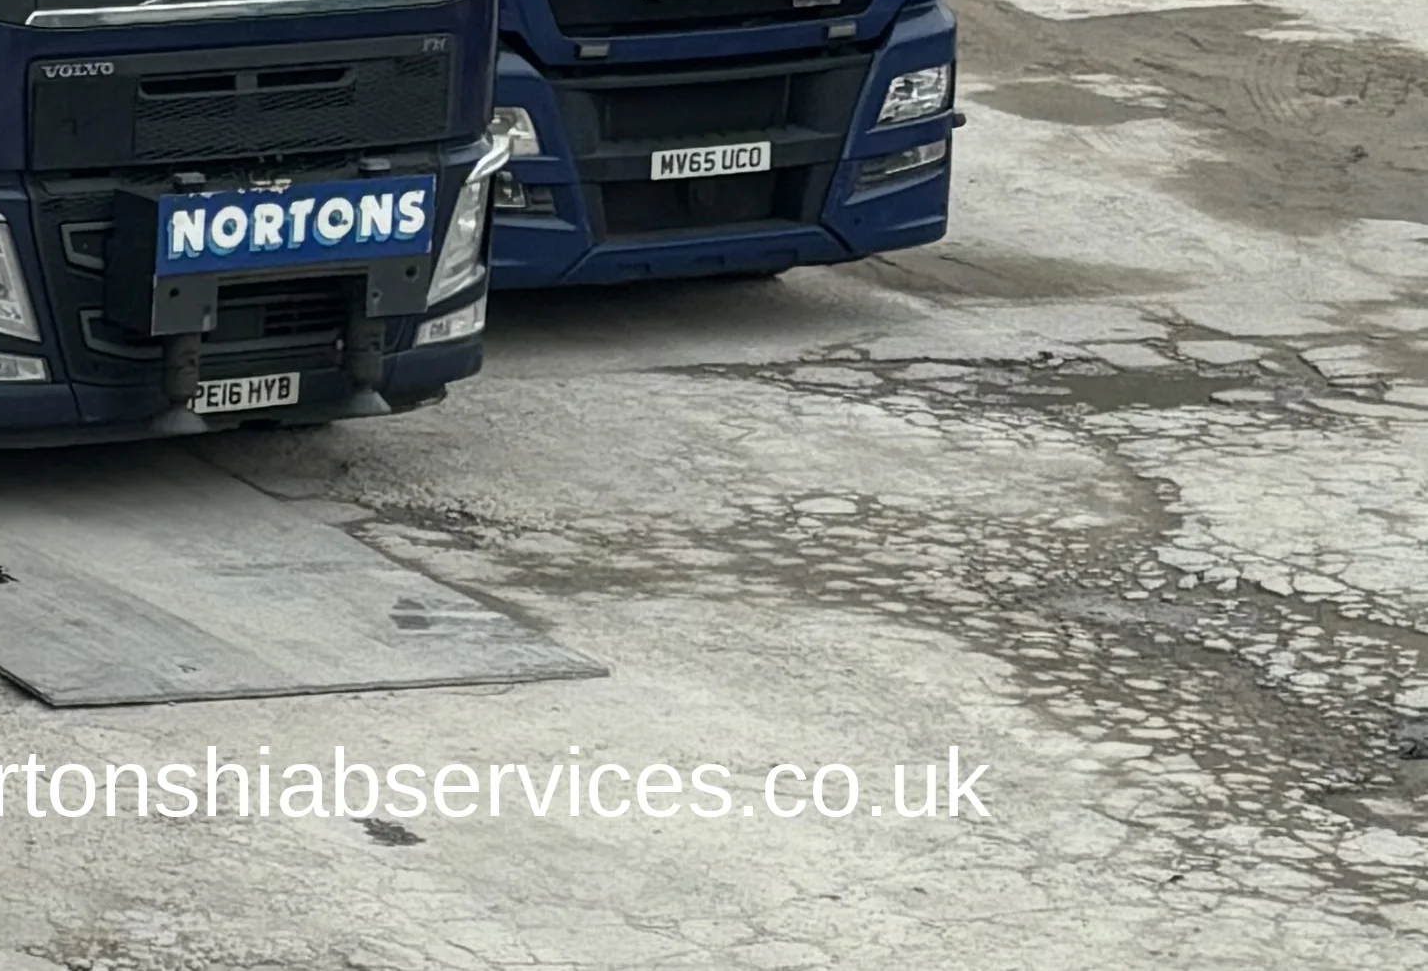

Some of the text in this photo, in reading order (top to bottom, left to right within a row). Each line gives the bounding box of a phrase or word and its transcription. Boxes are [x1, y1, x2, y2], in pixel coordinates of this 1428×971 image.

[42, 61, 115, 79] VOLVO
[660, 146, 762, 176] MV65 UCO
[168, 189, 426, 260] NORTONS
[191, 376, 291, 409] PE16 HYB
